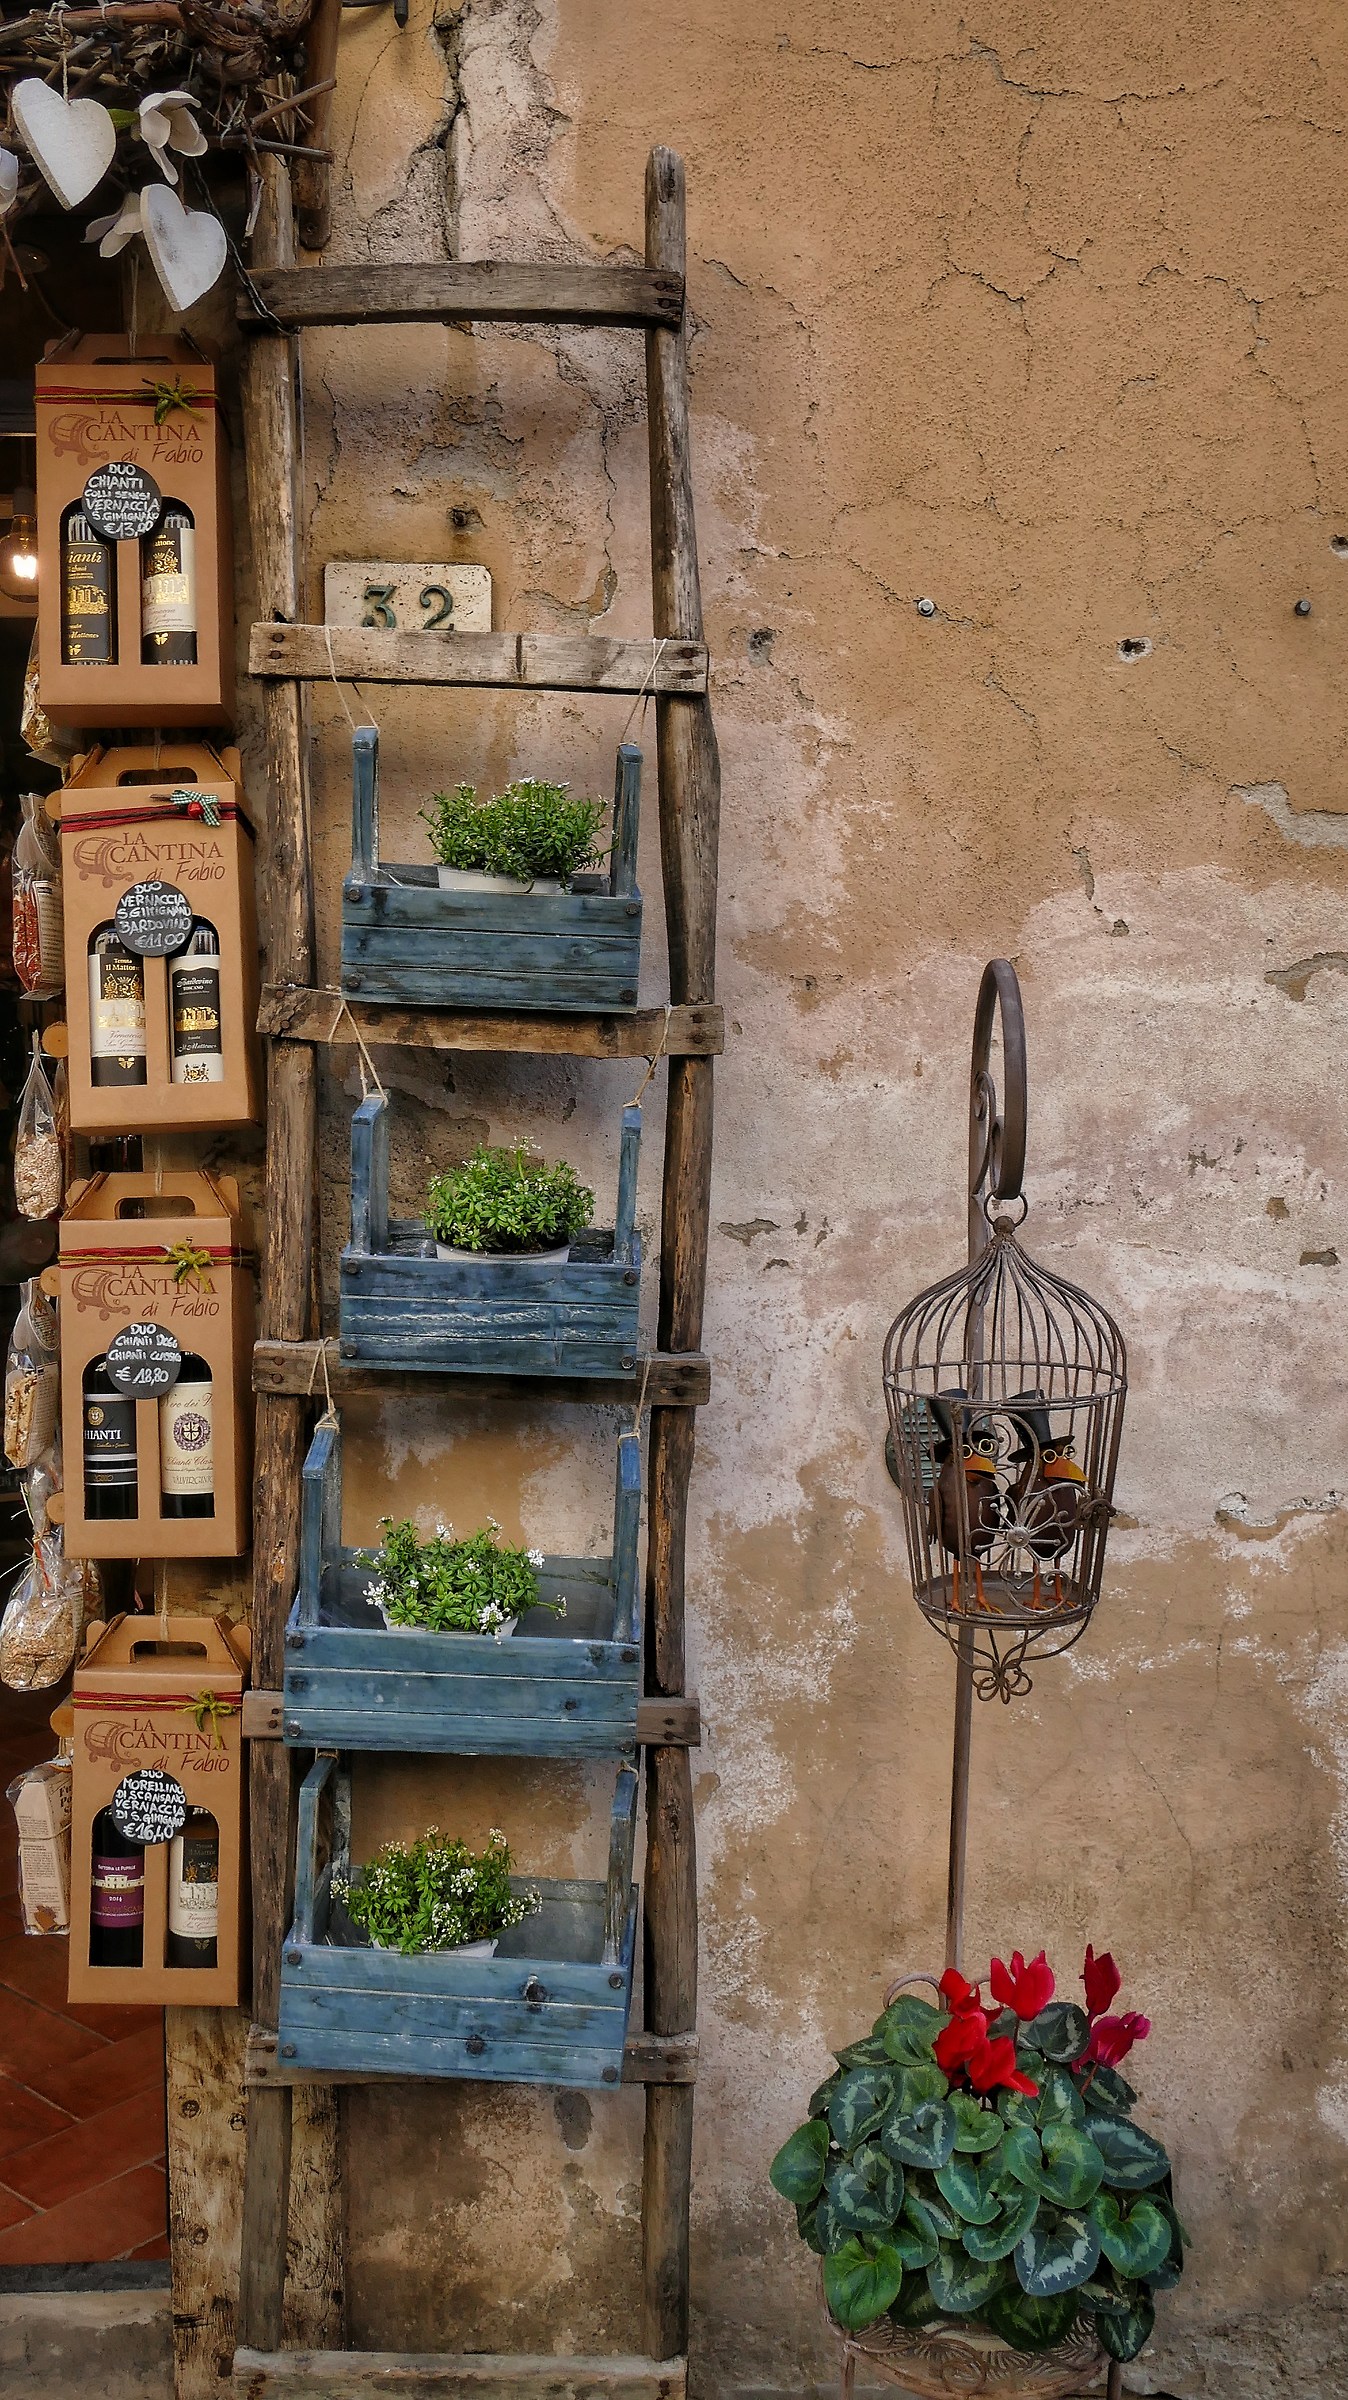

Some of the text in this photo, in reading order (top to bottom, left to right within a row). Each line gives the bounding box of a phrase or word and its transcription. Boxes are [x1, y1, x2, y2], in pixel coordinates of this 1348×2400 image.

[100, 410, 124, 424] LA
[85, 424, 203, 442] CANTINA
[121, 441, 204, 464] di Fabio
[108, 463, 136, 476] DUO
[88, 474, 144, 490] CHIANTI
[84, 489, 112, 498] COLLI
[85, 498, 160, 513] VERNACCIA
[69, 551, 102, 563] ianti
[361, 584, 455, 630] 32
[122, 832, 147, 846] LA
[110, 841, 224, 864] CANTINA
[145, 860, 226, 882] di Fabio
[134, 881, 162, 894] DUO
[120, 893, 187, 908] VERNACCIA
[121, 1265, 145, 1279] LA
[107, 1278, 219, 1297] CANTINA
[142, 1295, 220, 1317] di Fabio
[130, 1323, 157, 1335] DUO
[115, 1335, 153, 1347] CHIANTI
[108, 1348, 147, 1361] CHIANTI
[85, 1429, 122, 1440] HIANTI
[133, 1718, 156, 1732] LA
[119, 1731, 229, 1751] CANTINA
[152, 1751, 230, 1772] di Fabio
[140, 1769, 164, 1779] DUO
[122, 1777, 184, 1795] MORELLINO
[115, 1789, 186, 1804] DI SCANSANO
[115, 1798, 186, 1818] VERNACCIA
[115, 1809, 128, 1820] DI
